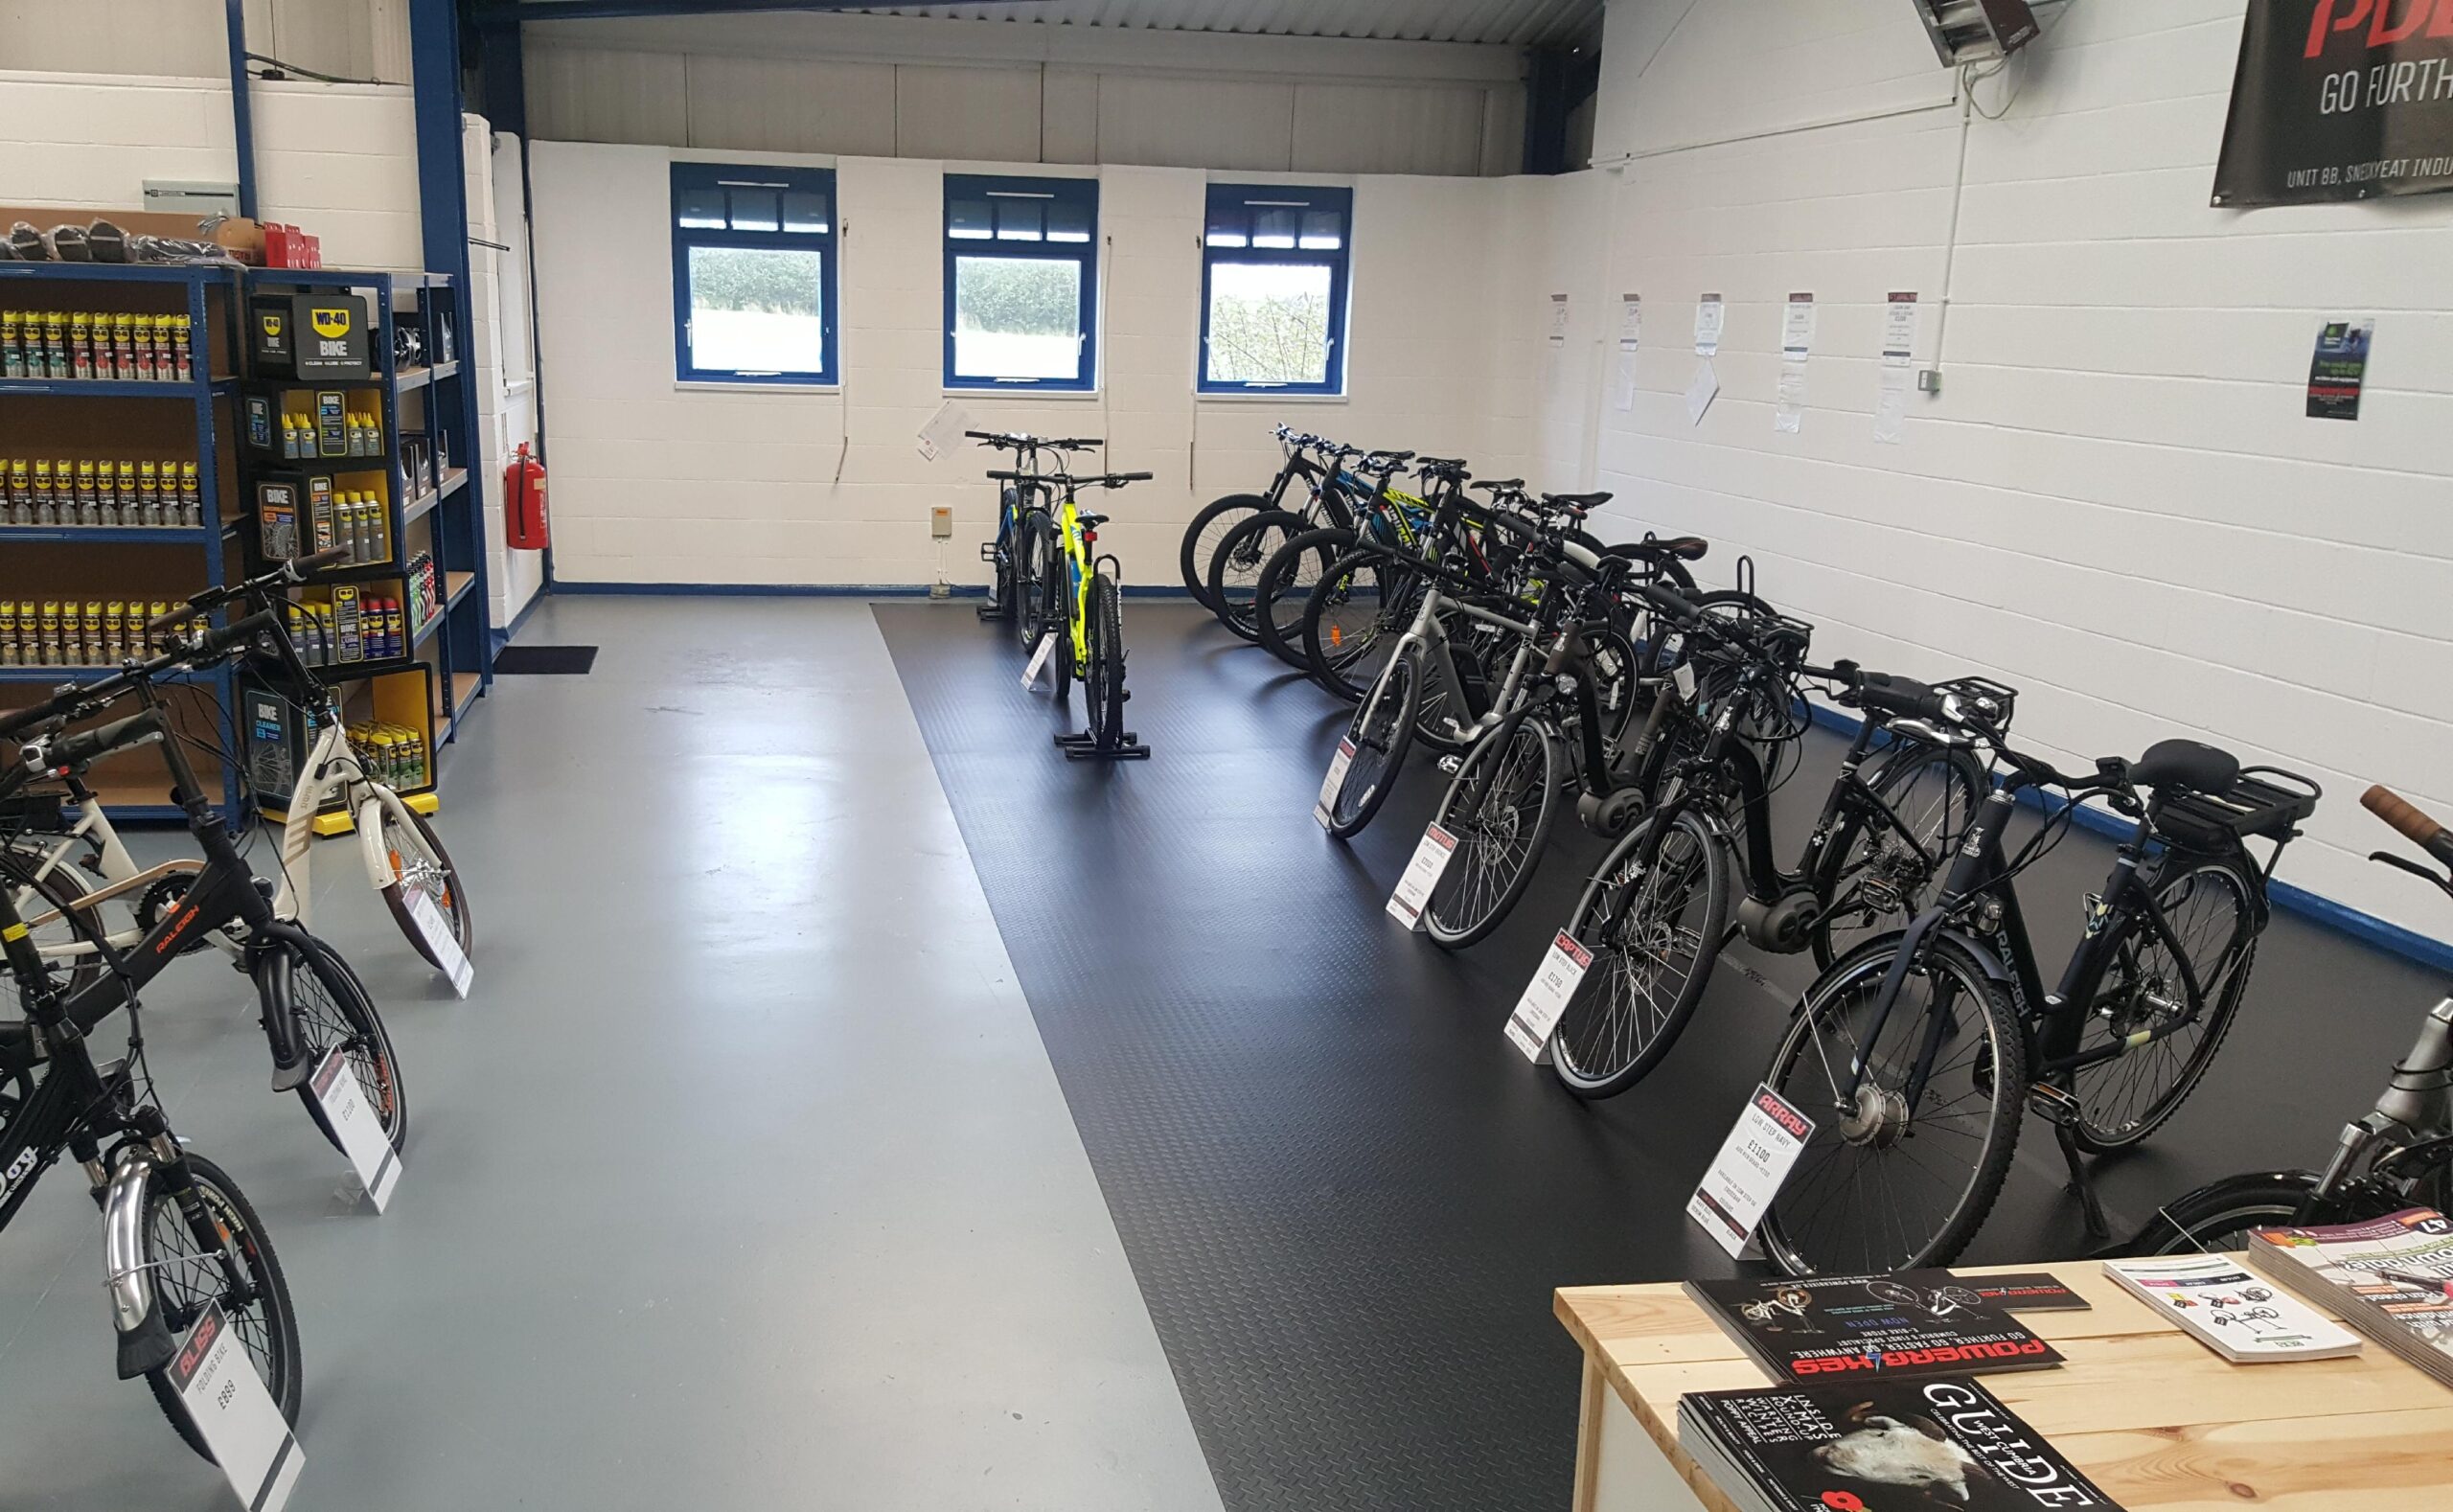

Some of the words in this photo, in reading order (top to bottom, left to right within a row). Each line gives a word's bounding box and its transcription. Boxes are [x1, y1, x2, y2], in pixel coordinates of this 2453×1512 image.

[2320, 70, 2360, 115] GO
[2287, 168, 2319, 188] UNIT
[315, 311, 347, 326] WD-40
[319, 340, 348, 356] BIKE
[266, 489, 289, 505] BIKE
[313, 482, 328, 492] BIKE
[340, 624, 356, 633] BIKE
[258, 703, 278, 722] BIKE
[1429, 826, 1456, 851] MOTUS
[156, 904, 200, 954] RALEIGH
[1556, 933, 1591, 968] CAPTUS
[1757, 1093, 1808, 1136] ARRAY
[1752, 1112, 1763, 1128] LOW
[1763, 1121, 1777, 1136] STEP
[1776, 1132, 1791, 1149] NAVY
[1747, 1138, 1771, 1163] £1100
[223, 1205, 244, 1232] HIGH
[2419, 1219, 2448, 1233] 47
[2405, 1290, 2444, 1299] Plan
[1845, 1318, 1880, 1329] OPEN
[1860, 1328, 1890, 1337] STORE
[1881, 1317, 1910, 1326] NOW
[1891, 1327, 1919, 1336] E-BIKE
[1837, 1335, 1895, 1347] SPECIALIST
[1896, 1333, 1919, 1343] FIRST
[1919, 1331, 1959, 1342] CUMBRIA'S
[1926, 1338, 1949, 1347] GO
[2009, 1331, 2027, 1340] GO
[196, 1360, 218, 1395] FOLDING
[215, 1341, 229, 1363] BIKE
[217, 1379, 237, 1410] £899
[1720, 1399, 1742, 1422] POPPY
[1739, 1420, 1764, 1444] APPEAL
[1735, 1398, 1779, 1443] RECIPES
[1746, 1397, 1789, 1443] WINTER
[1755, 1397, 1799, 1442] WARMING
[1770, 1396, 1815, 1441] ROUND-UP
[1779, 1395, 1828, 1440] X-MAS
[1793, 1394, 1843, 1438] INSIDE
[1923, 1383, 2095, 1508] GUIDE
[1930, 1408, 1965, 1440] CELEBRATING
[1963, 1438, 1976, 1451] THE
[1972, 1448, 1986, 1461] BEST
[1983, 1458, 1993, 1469] OF
[1989, 1466, 2004, 1478] THE
[2001, 1475, 2022, 1491] WEST
[1972, 1418, 2002, 1441] WEST
[1996, 1440, 2037, 1477] CUMBRIA
